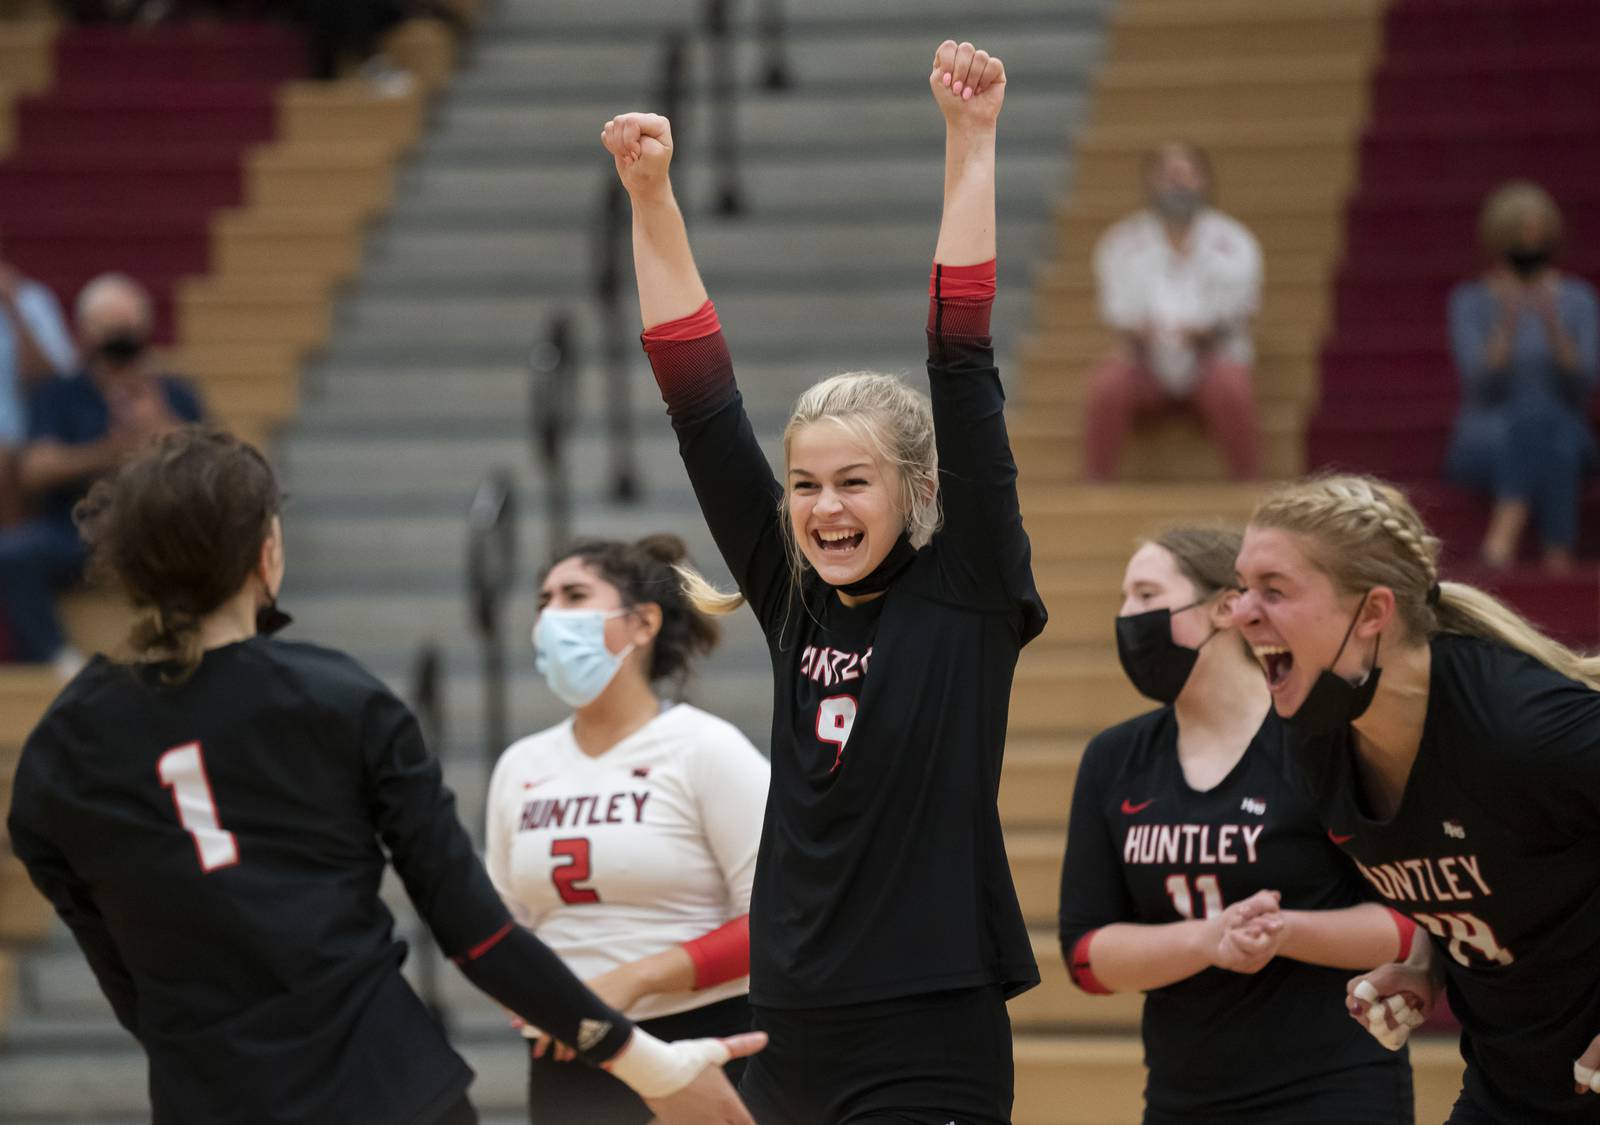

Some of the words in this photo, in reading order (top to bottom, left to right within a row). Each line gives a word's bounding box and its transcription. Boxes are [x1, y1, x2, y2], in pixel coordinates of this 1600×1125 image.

[815, 694, 859, 774] 9
[156, 739, 240, 874] 1
[519, 791, 649, 832] HUNTLEY
[549, 837, 602, 906] 2
[1123, 824, 1264, 864] HUNTLEY
[1165, 874, 1225, 921] 11
